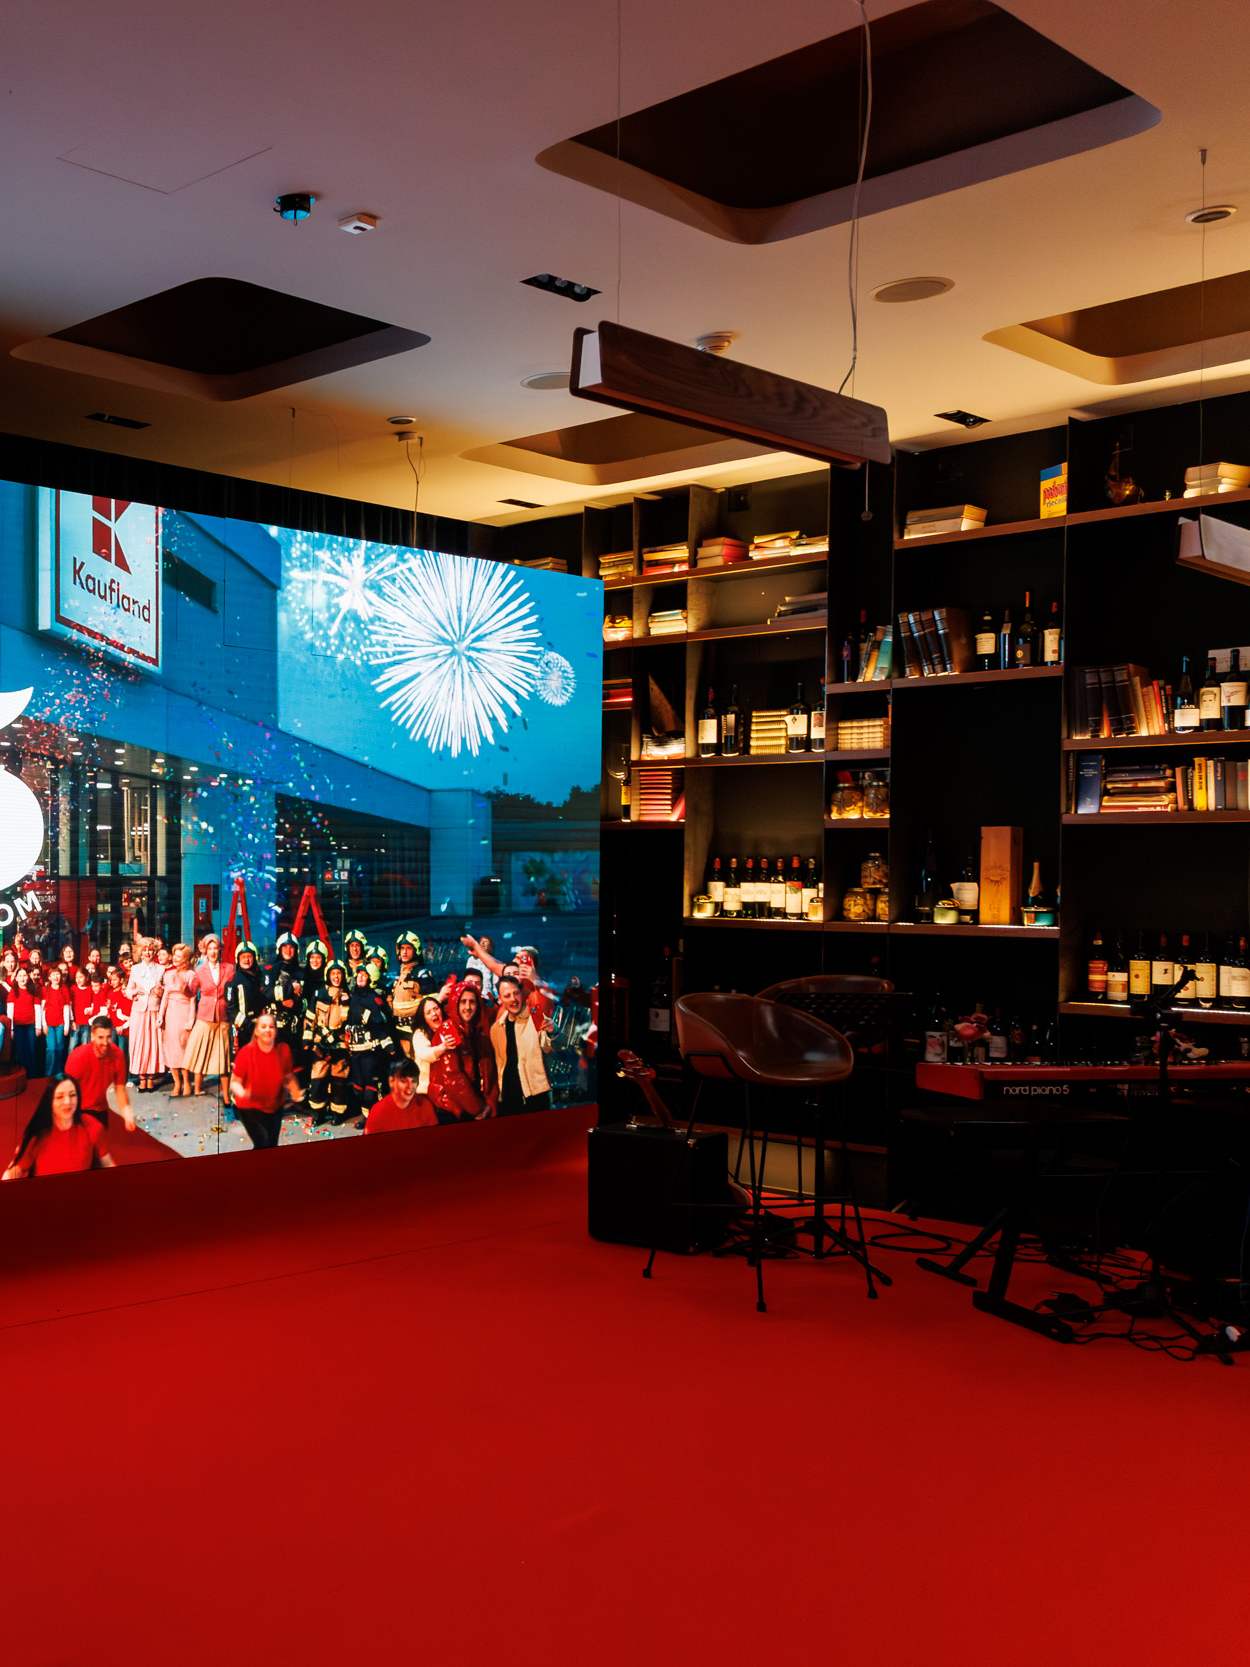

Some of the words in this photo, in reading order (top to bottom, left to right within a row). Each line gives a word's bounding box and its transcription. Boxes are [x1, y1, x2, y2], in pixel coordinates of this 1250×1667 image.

[72, 556, 152, 624] Kaufland
[1003, 1085, 1030, 1095] nord
[1030, 1086, 1062, 1096] piano
[1062, 1084, 1070, 1095] 5
